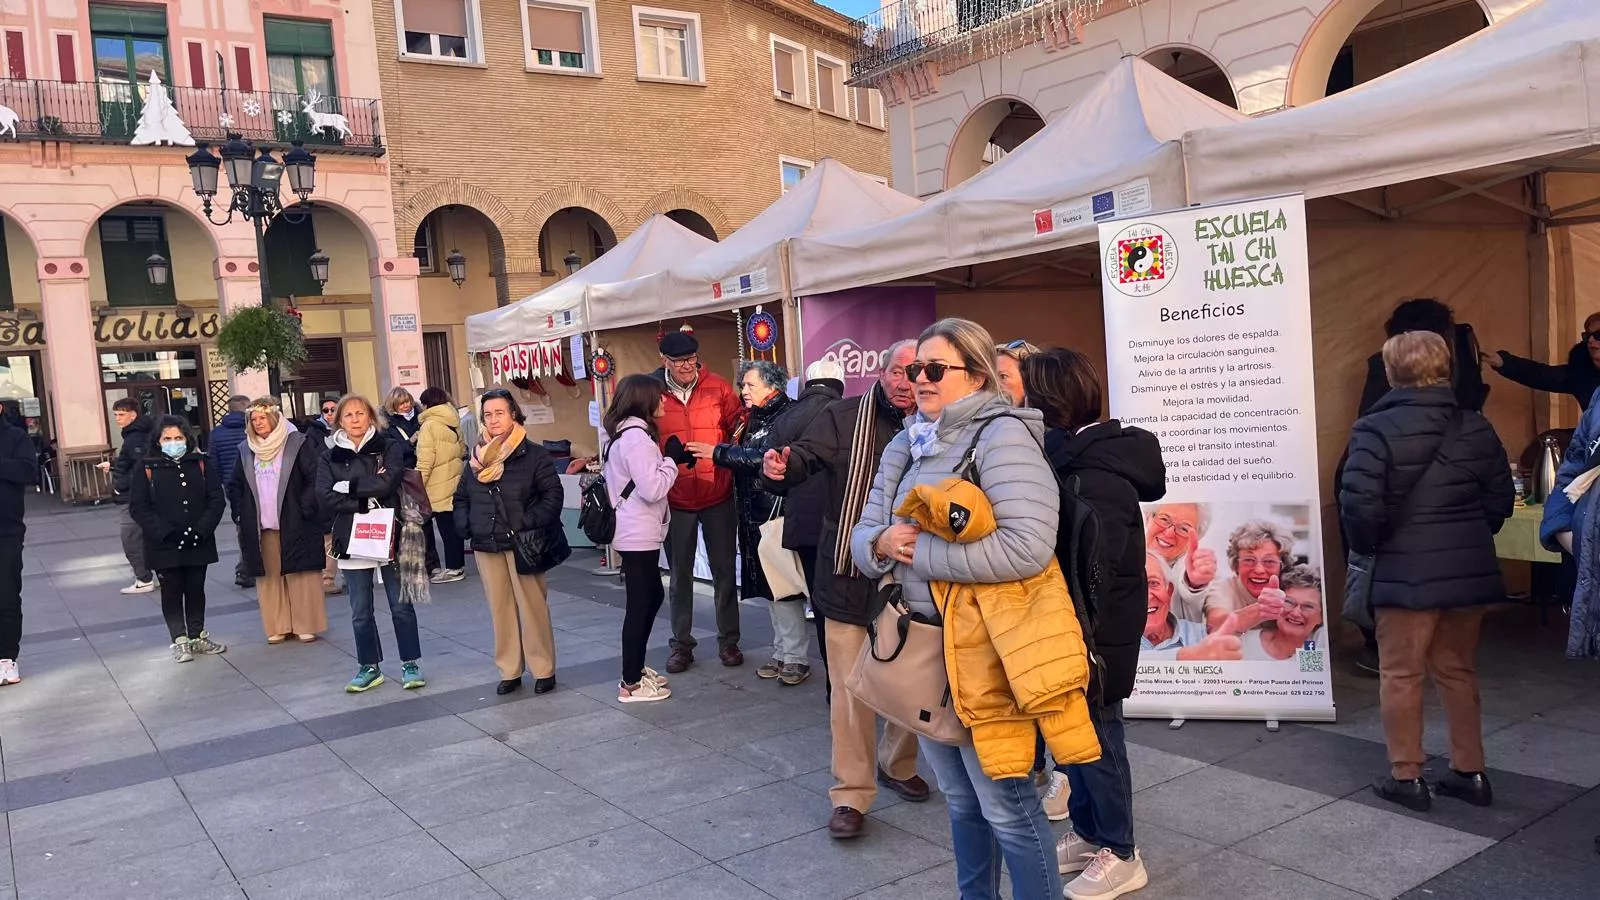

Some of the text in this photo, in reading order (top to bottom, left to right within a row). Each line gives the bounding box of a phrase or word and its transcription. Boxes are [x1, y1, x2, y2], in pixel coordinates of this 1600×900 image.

[1062, 215, 1082, 225] Huesca
[1195, 208, 1288, 241] ESCUELA
[1207, 236, 1277, 266] TAI CHI
[1110, 247, 1118, 279] ESCUELA
[1204, 263, 1284, 291] HUESCA
[1160, 303, 1245, 322] Beneficios
[1128, 329, 1282, 348] Disminuye los dolores de espalda.
[493, 344, 561, 376] BOLSKAN
[1134, 353, 1164, 364] Mejora
[1166, 352, 1175, 361] la
[1177, 350, 1224, 360] circulación
[1138, 370, 1162, 378] Alivio
[1165, 368, 1176, 376] de
[1189, 366, 1217, 374] artritis
[1227, 364, 1235, 372] la
[1238, 362, 1274, 371] artrosis.
[1131, 376, 1284, 393] Disminuye el estrés y la ansiedad.
[1163, 398, 1193, 407] Mejora
[1206, 395, 1252, 404] movilidad.
[1120, 409, 1301, 424] Aumenta la capacidad de concentración.
[1169, 427, 1211, 437] coordinar
[1213, 426, 1227, 434] los
[1229, 424, 1290, 433] movimientos.
[1234, 440, 1278, 449] intestinal.
[1165, 460, 1179, 468] ora
[1182, 459, 1190, 467] la
[1192, 458, 1224, 466] calidad
[1227, 457, 1240, 465] del
[1183, 473, 1230, 482] elasticidad
[1233, 474, 1238, 482] y
[1241, 472, 1249, 480] el
[1252, 471, 1296, 481] equilibrio.
[1136, 666, 1161, 675] CUELA
[1164, 666, 1175, 675] TAI
[1193, 666, 1223, 675] HUESCA
